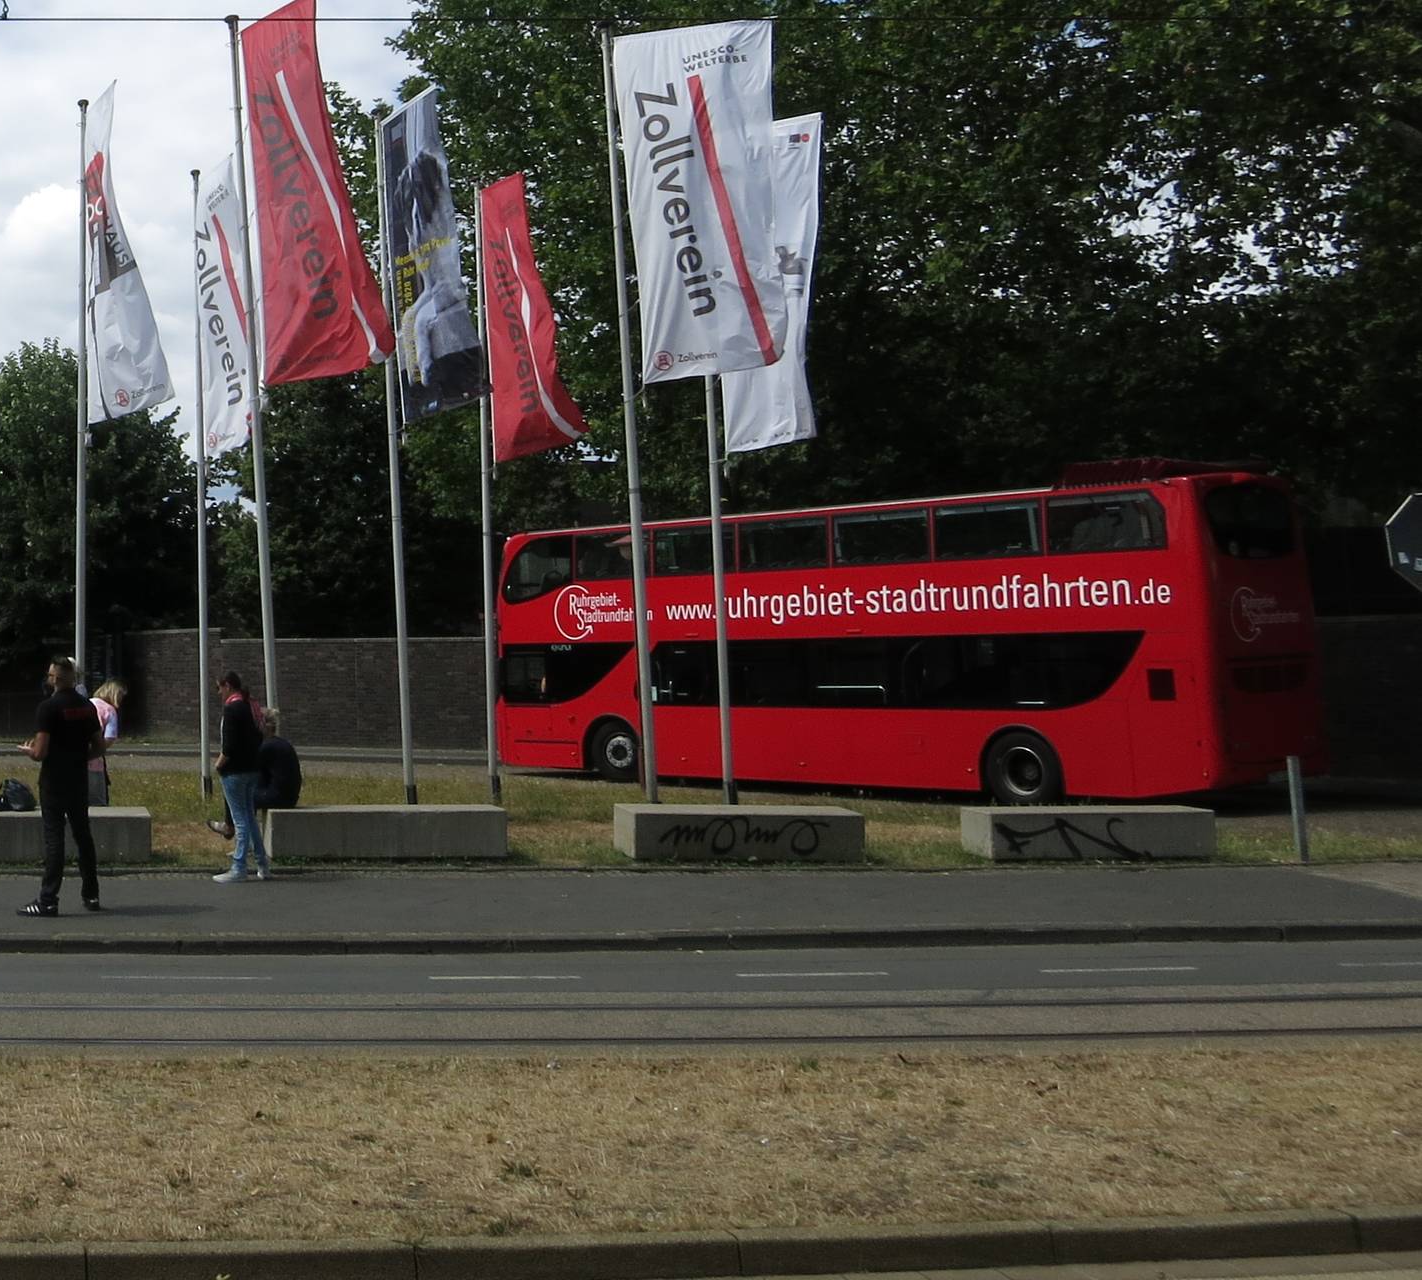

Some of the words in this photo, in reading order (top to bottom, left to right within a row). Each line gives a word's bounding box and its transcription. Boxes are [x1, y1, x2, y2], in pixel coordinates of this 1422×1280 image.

[682, 44, 739, 64] UNESCO-
[684, 54, 748, 73] WELTERBE
[634, 82, 723, 317] Zollverein
[195, 221, 247, 406] Zollverein
[569, 592, 621, 615] Ruhrgebiet-
[666, 573, 1171, 624] www.uhrgebiet-stadtrundfahrten.de
[577, 607, 653, 630] Stadtrundfahn
